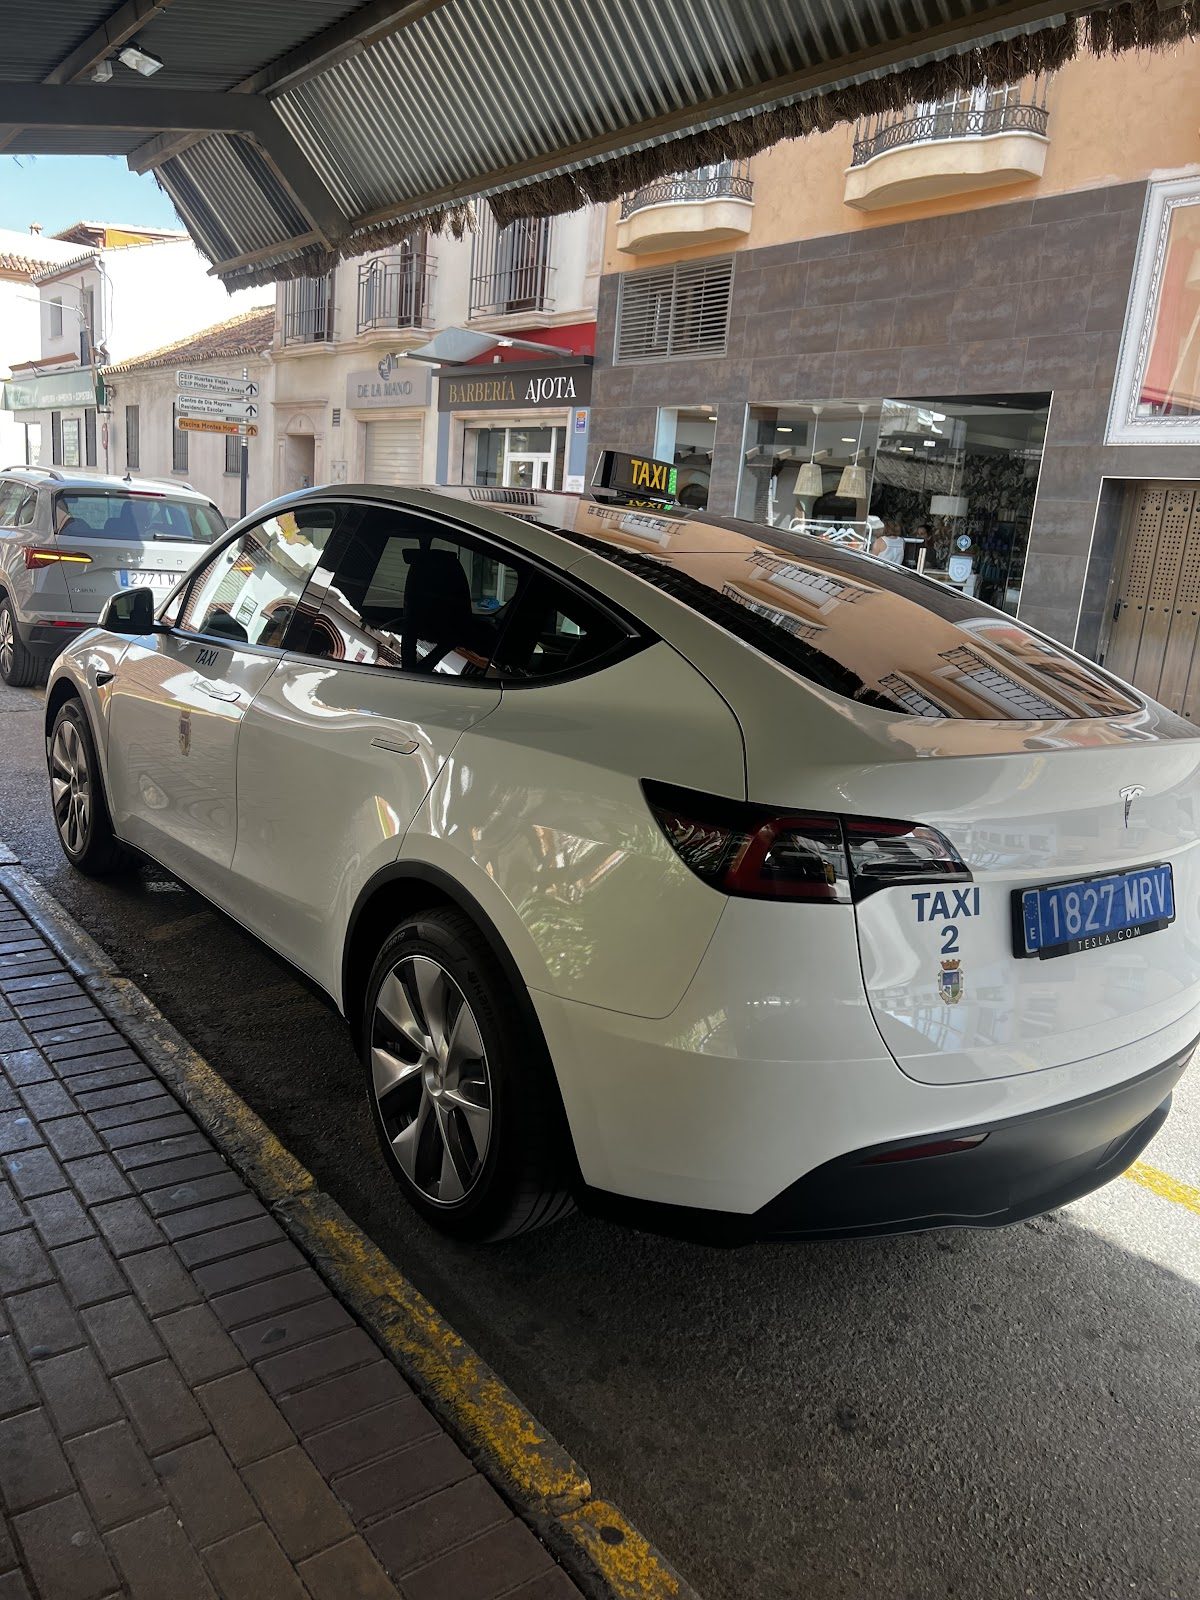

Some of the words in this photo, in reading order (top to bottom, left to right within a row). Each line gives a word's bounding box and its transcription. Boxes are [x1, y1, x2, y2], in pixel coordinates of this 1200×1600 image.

[194, 375, 214, 383] Huertas
[358, 384, 369, 398] DE
[371, 384, 381, 396] LA
[384, 381, 412, 396] MANO
[449, 376, 515, 402] BARBERÍA
[524, 376, 576, 404] AJOTA
[630, 460, 668, 490] TAXI
[131, 573, 163, 584] 2771
[195, 648, 219, 666] TAXI
[912, 887, 980, 922] TAXI
[1049, 884, 1115, 938] 1827
[1124, 873, 1166, 921] MRV
[940, 925, 960, 954] 2
[1030, 928, 1036, 940] E
[1078, 928, 1142, 952] TESLA.COM
